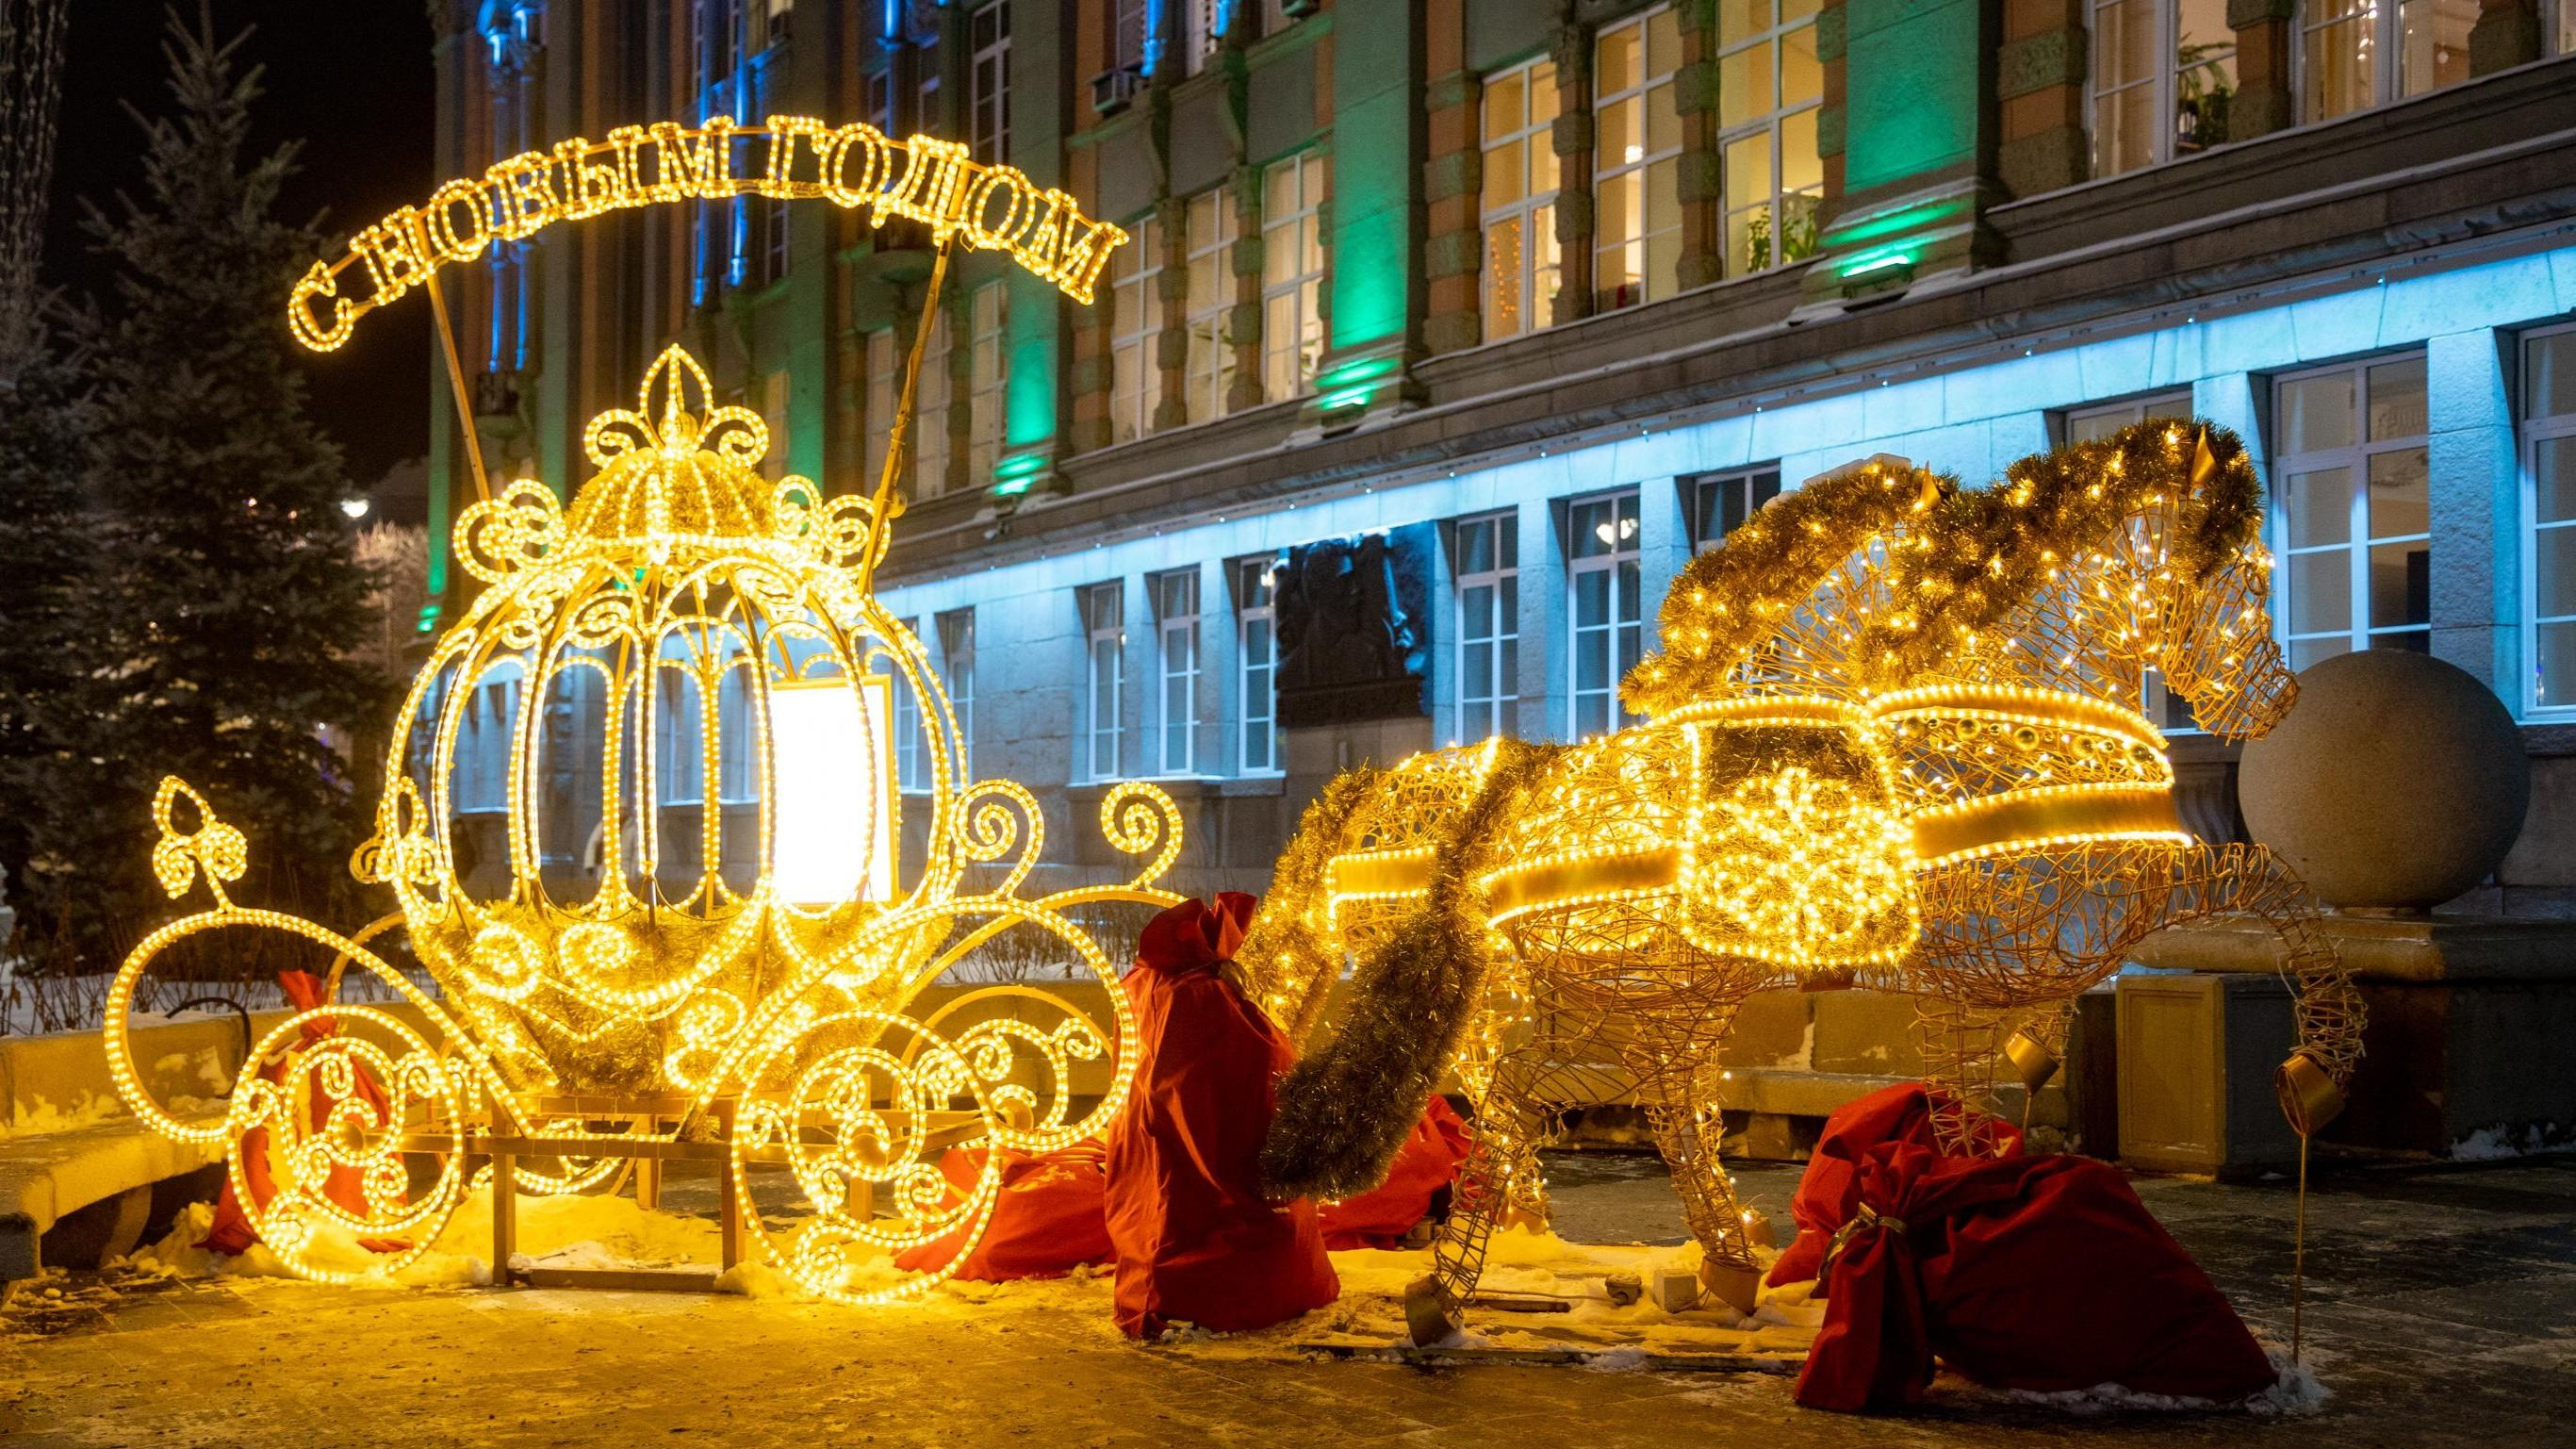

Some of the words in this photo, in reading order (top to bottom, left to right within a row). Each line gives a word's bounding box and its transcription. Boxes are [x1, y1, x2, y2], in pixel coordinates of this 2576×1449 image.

[287, 259, 353, 353] С
[349, 115, 735, 305] НОВЫМ
[765, 114, 1130, 305] ГОДОМ
